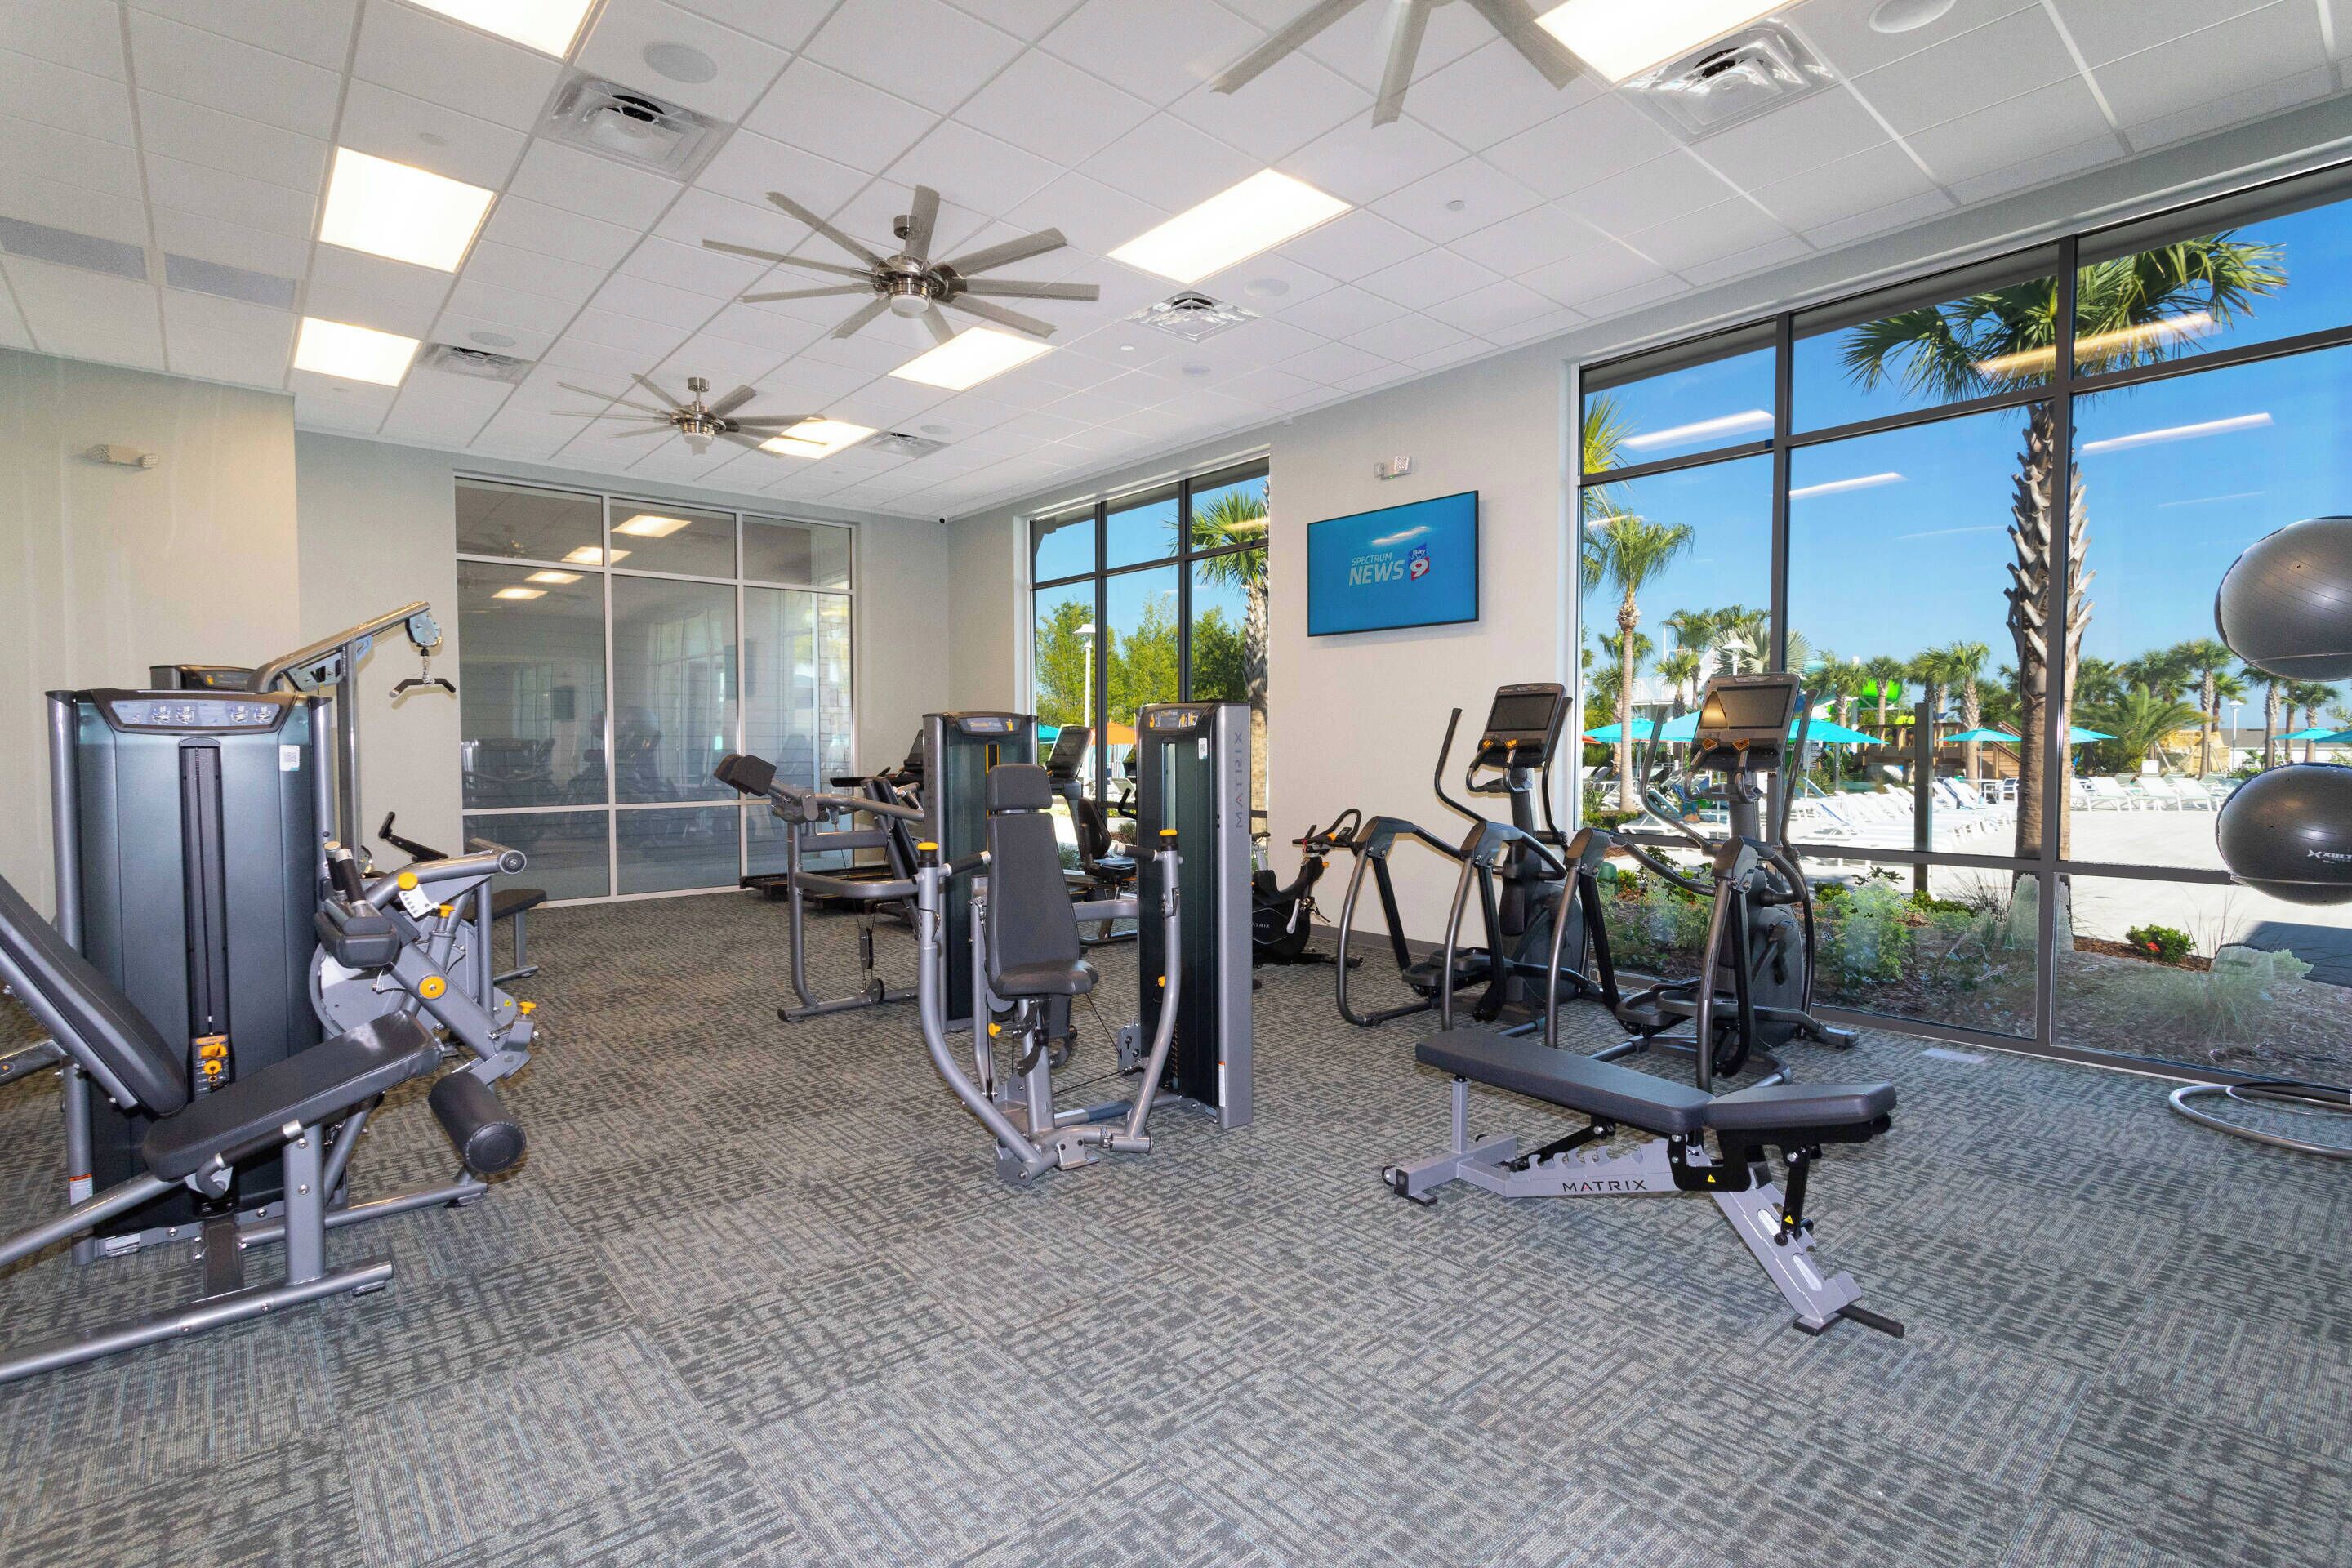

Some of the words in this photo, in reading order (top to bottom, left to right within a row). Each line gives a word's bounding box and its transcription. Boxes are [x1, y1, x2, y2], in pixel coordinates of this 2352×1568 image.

[1352, 552, 1392, 567] SPECTRUM
[1410, 559, 1429, 577] 9
[1348, 559, 1405, 586] NEWS
[1234, 732, 1243, 828] MATRIX
[1562, 1179, 1648, 1192] MATRIX
